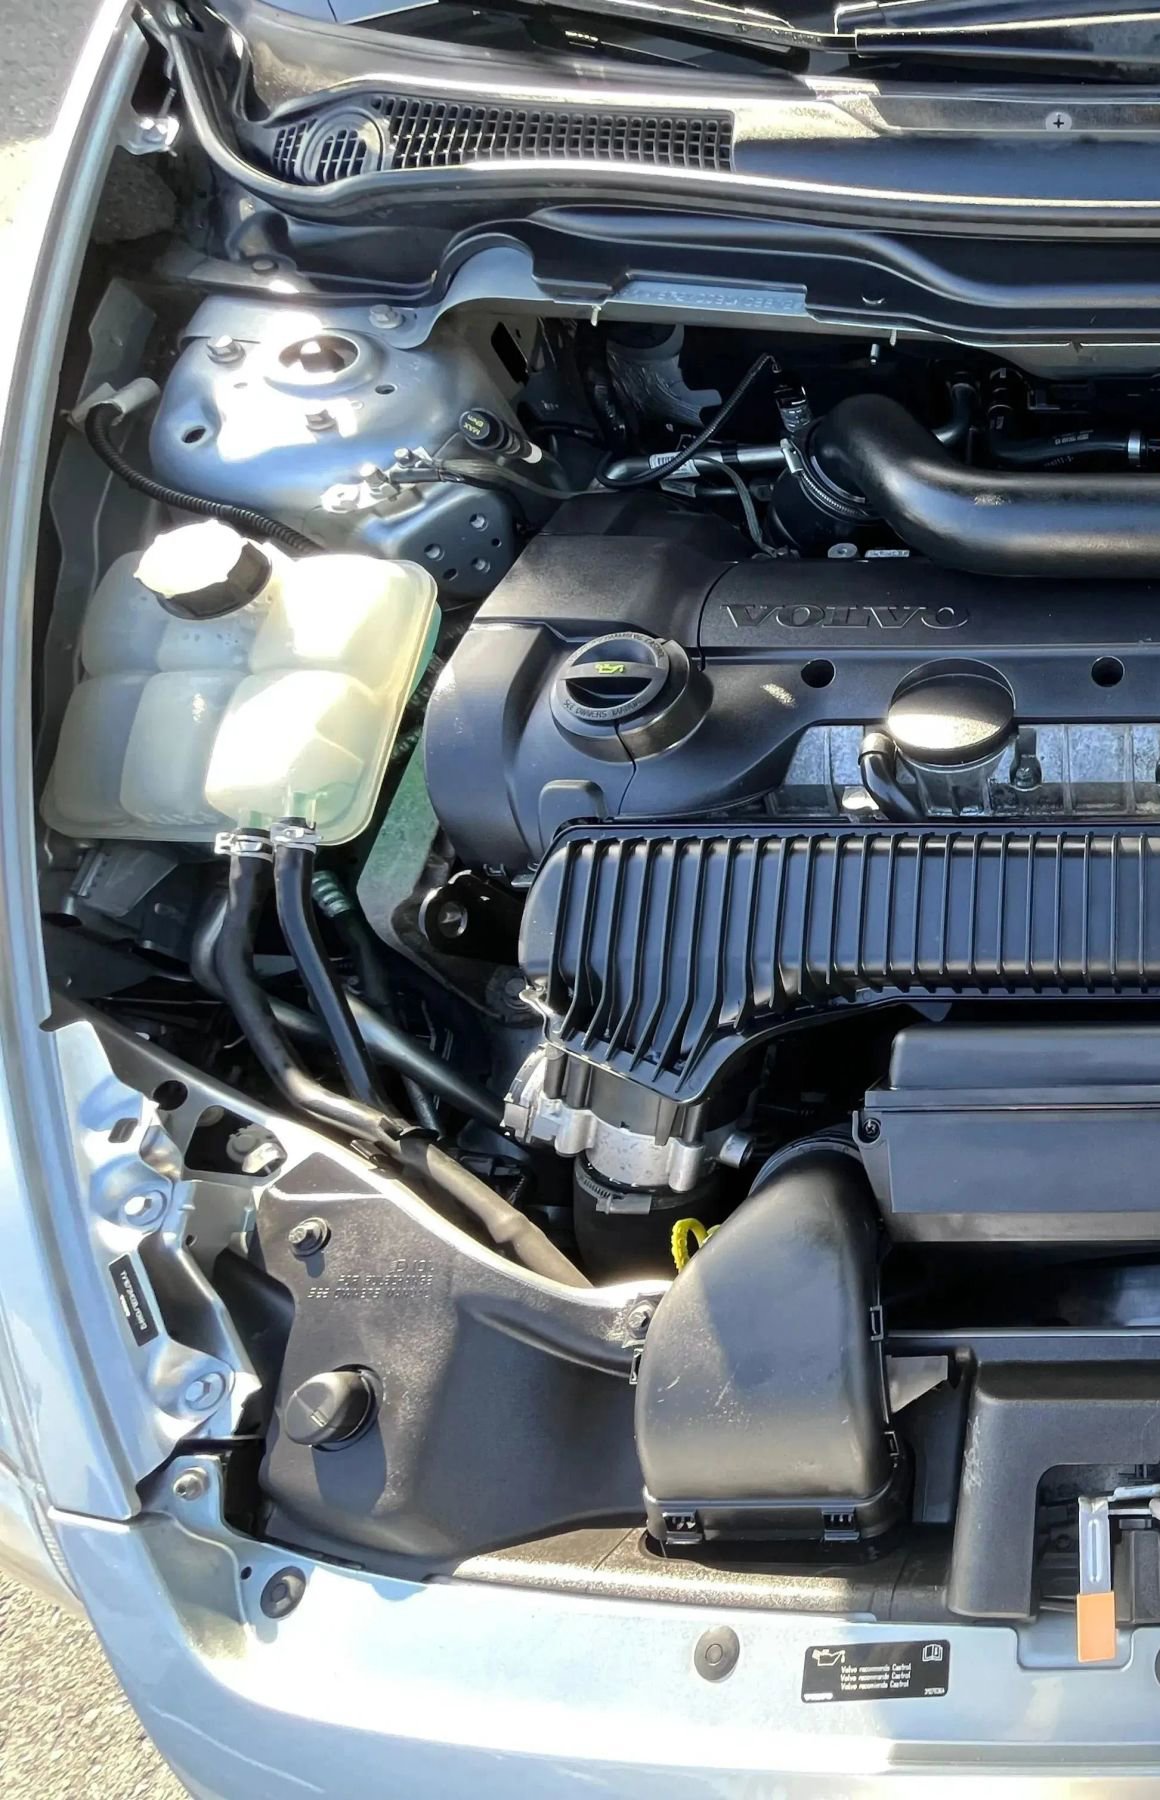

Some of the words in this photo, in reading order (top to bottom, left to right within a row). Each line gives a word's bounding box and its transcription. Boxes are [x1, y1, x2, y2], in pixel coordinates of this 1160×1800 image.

[720, 604, 969, 629] VOLVO
[841, 1665, 858, 1674] Volvo
[892, 1663, 912, 1671] Castrol
[840, 1674, 857, 1682] Volvo
[892, 1671, 911, 1680] Castrol
[840, 1682, 858, 1690] Volvo
[890, 1680, 909, 1688] Castrol
